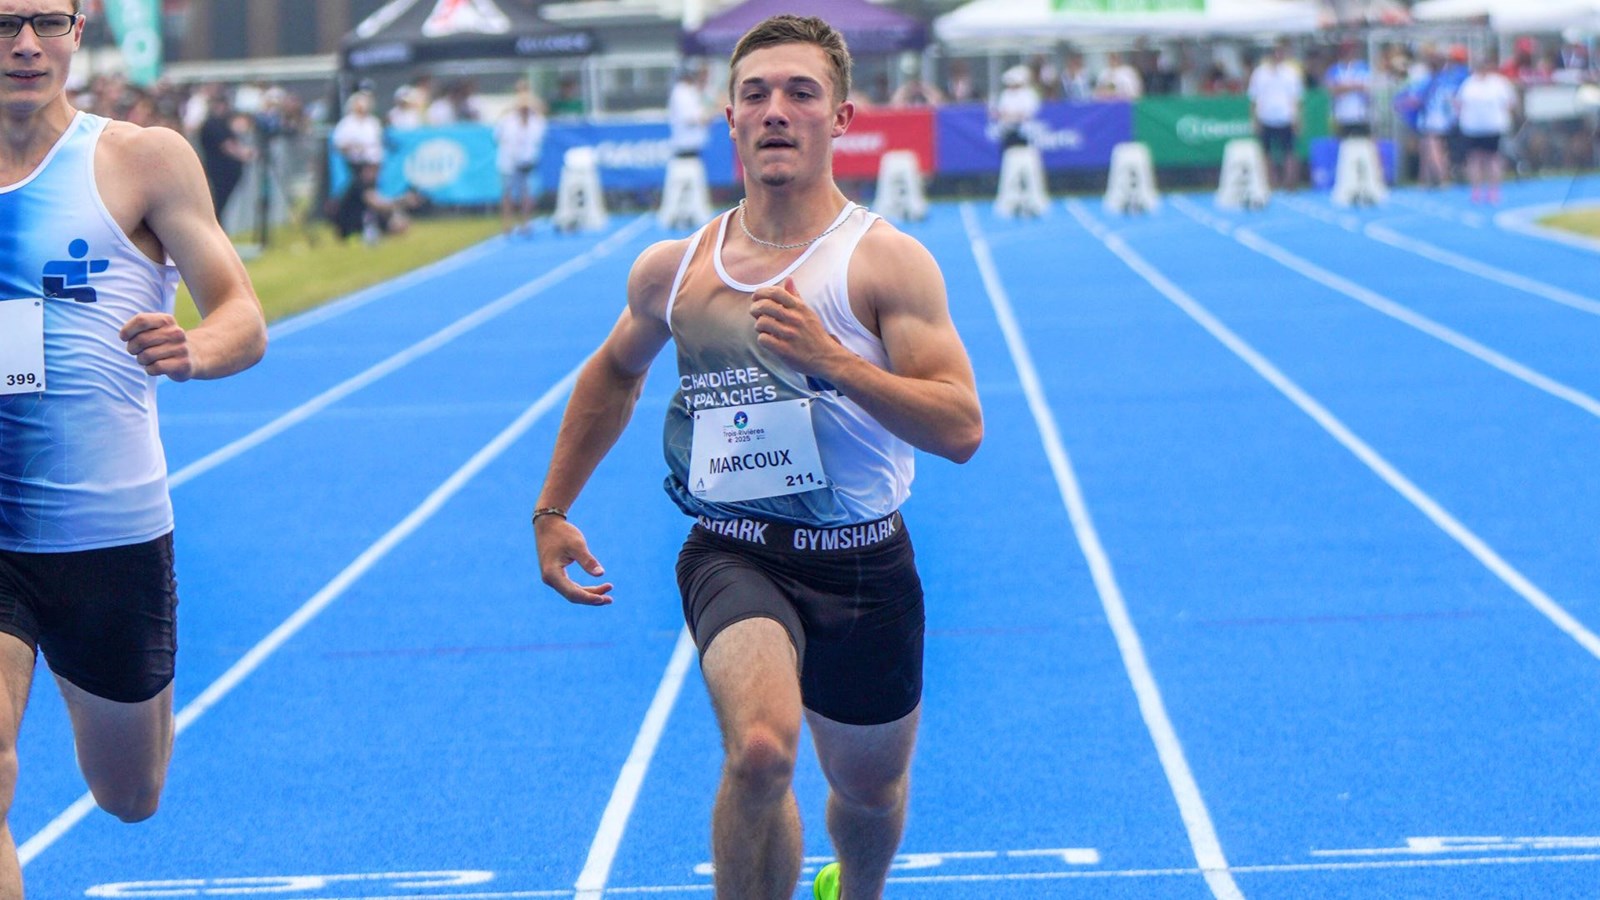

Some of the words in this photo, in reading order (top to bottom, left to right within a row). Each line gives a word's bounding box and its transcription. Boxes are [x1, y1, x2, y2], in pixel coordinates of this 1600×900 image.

[6, 372, 36, 386] 399
[709, 449, 793, 474] MARCOUX
[785, 472, 815, 486] 211
[793, 515, 896, 550] GYMSHARK
